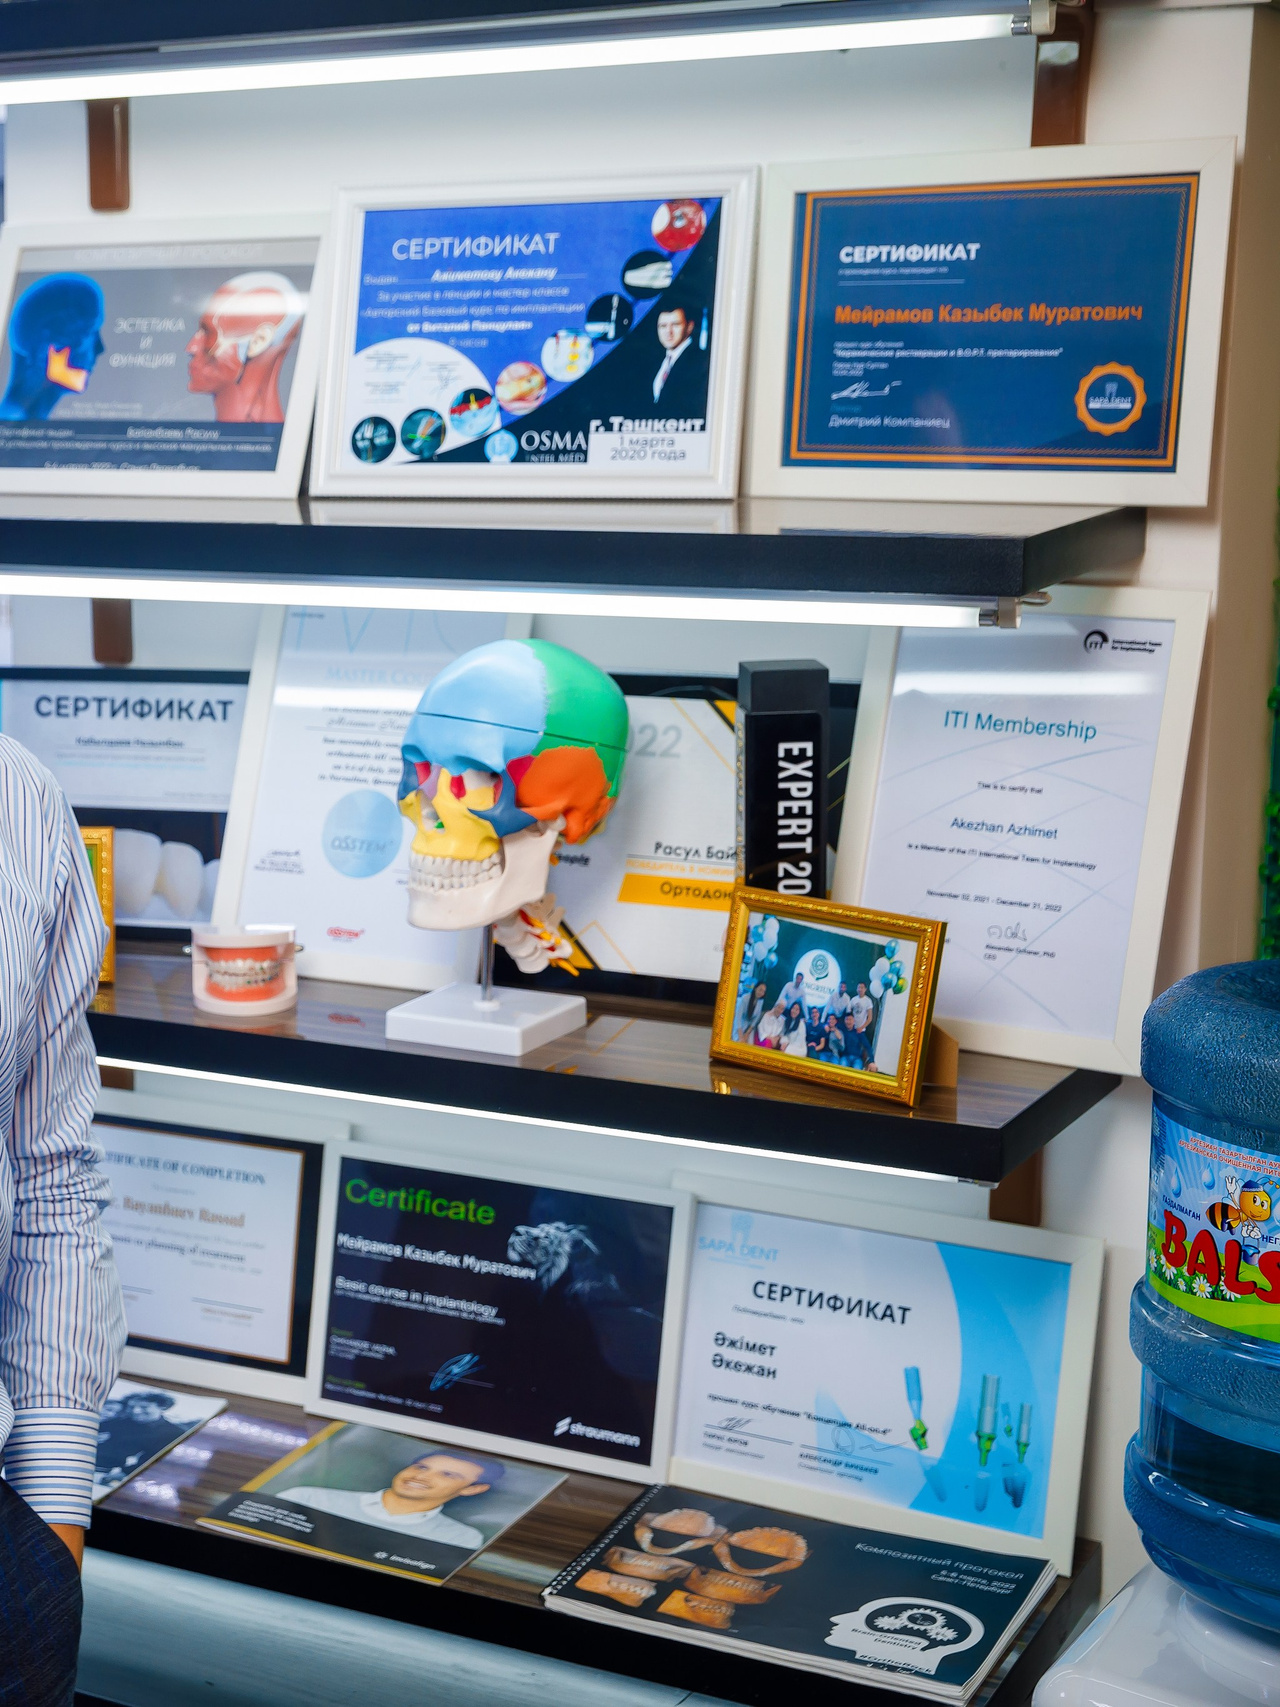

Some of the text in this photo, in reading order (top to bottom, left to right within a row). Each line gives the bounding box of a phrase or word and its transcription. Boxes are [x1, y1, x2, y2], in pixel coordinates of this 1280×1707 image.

[391, 232, 561, 261] СЕРТИФИКАТ
[838, 242, 981, 264] СЕРТИФИКАТ
[114, 317, 186, 334] ЭСТЕТИКА
[834, 303, 1143, 327] Мейрамов Казыбек Муратович
[139, 335, 154, 349] И
[109, 352, 177, 368] ФУНКЦИЯ
[590, 416, 705, 433] г. Ташкент
[828, 414, 881, 429] Дмитрий
[520, 430, 587, 451] OSMA
[628, 437, 675, 448] марта
[609, 447, 687, 461] 2020 года
[35, 694, 234, 722] СЕРТИФИКАТ
[943, 711, 1097, 743] ITI Membership
[777, 741, 813, 854] EXPERT
[950, 816, 1059, 840] Akezhan Azhimet
[654, 841, 701, 862] Расул
[1178, 1139, 1218, 1160] АРТЕЗИАНСКАЯ
[1218, 1155, 1262, 1173] ОЧИЩЕННАЯ
[1190, 1137, 1218, 1152] АРТЕЗИАН
[345, 1178, 496, 1225] Certificate
[336, 1232, 403, 1258] Мейрамов
[404, 1243, 462, 1269] Казыбек
[462, 1253, 537, 1281] Муратович
[698, 1235, 735, 1252] SAPA
[740, 1244, 779, 1262] DENT
[1161, 1209, 1280, 1304] BALS
[335, 1275, 368, 1292] Basic
[368, 1283, 409, 1300] course
[409, 1288, 422, 1301] in
[423, 1291, 498, 1317] implantology
[752, 1280, 912, 1326] СЕРТИФИКАТ
[713, 1331, 778, 1357] Әжімет
[711, 1352, 777, 1380] Әкежан
[569, 1422, 640, 1447] straumann
[854, 1542, 1025, 1580] Композитный протокол
